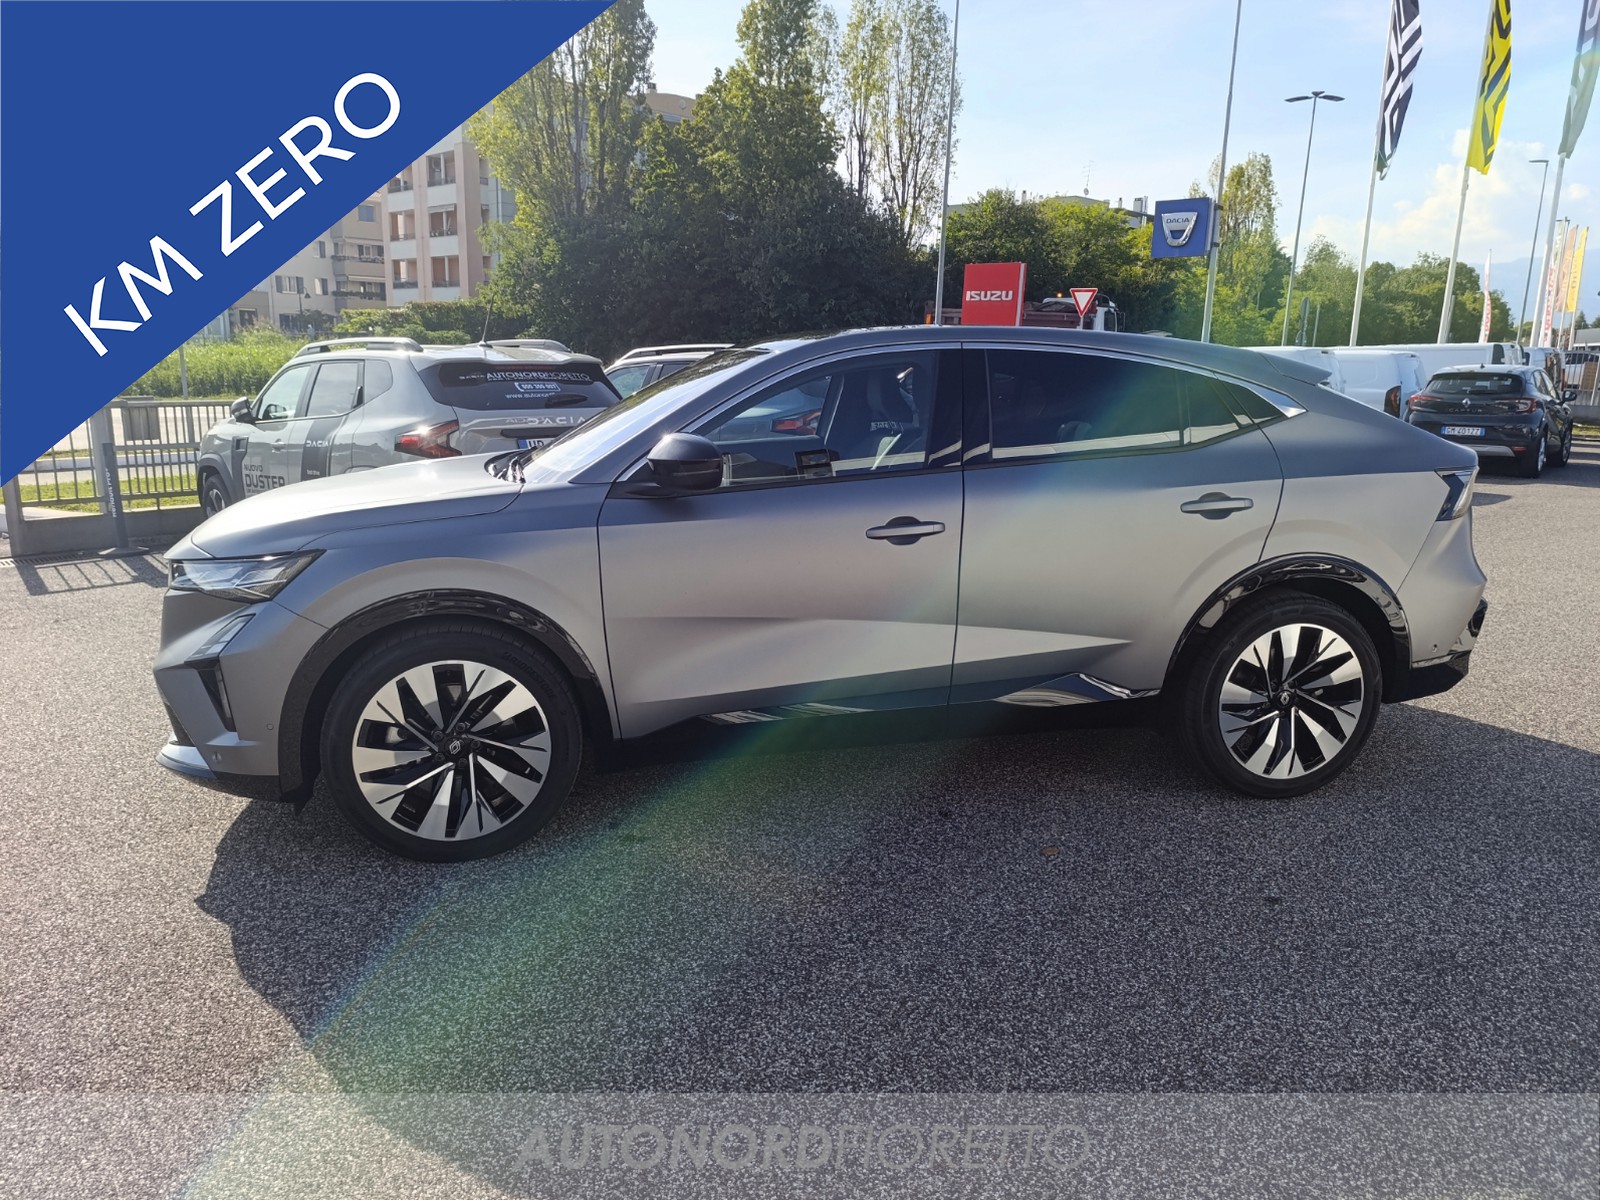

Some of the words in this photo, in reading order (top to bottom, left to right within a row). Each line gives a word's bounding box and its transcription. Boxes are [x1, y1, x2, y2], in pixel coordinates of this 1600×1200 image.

[965, 290, 1013, 302] ISUZU
[527, 416, 586, 425] DACIA
[243, 463, 263, 472] NUOVO
[244, 473, 286, 489] DUSTER
